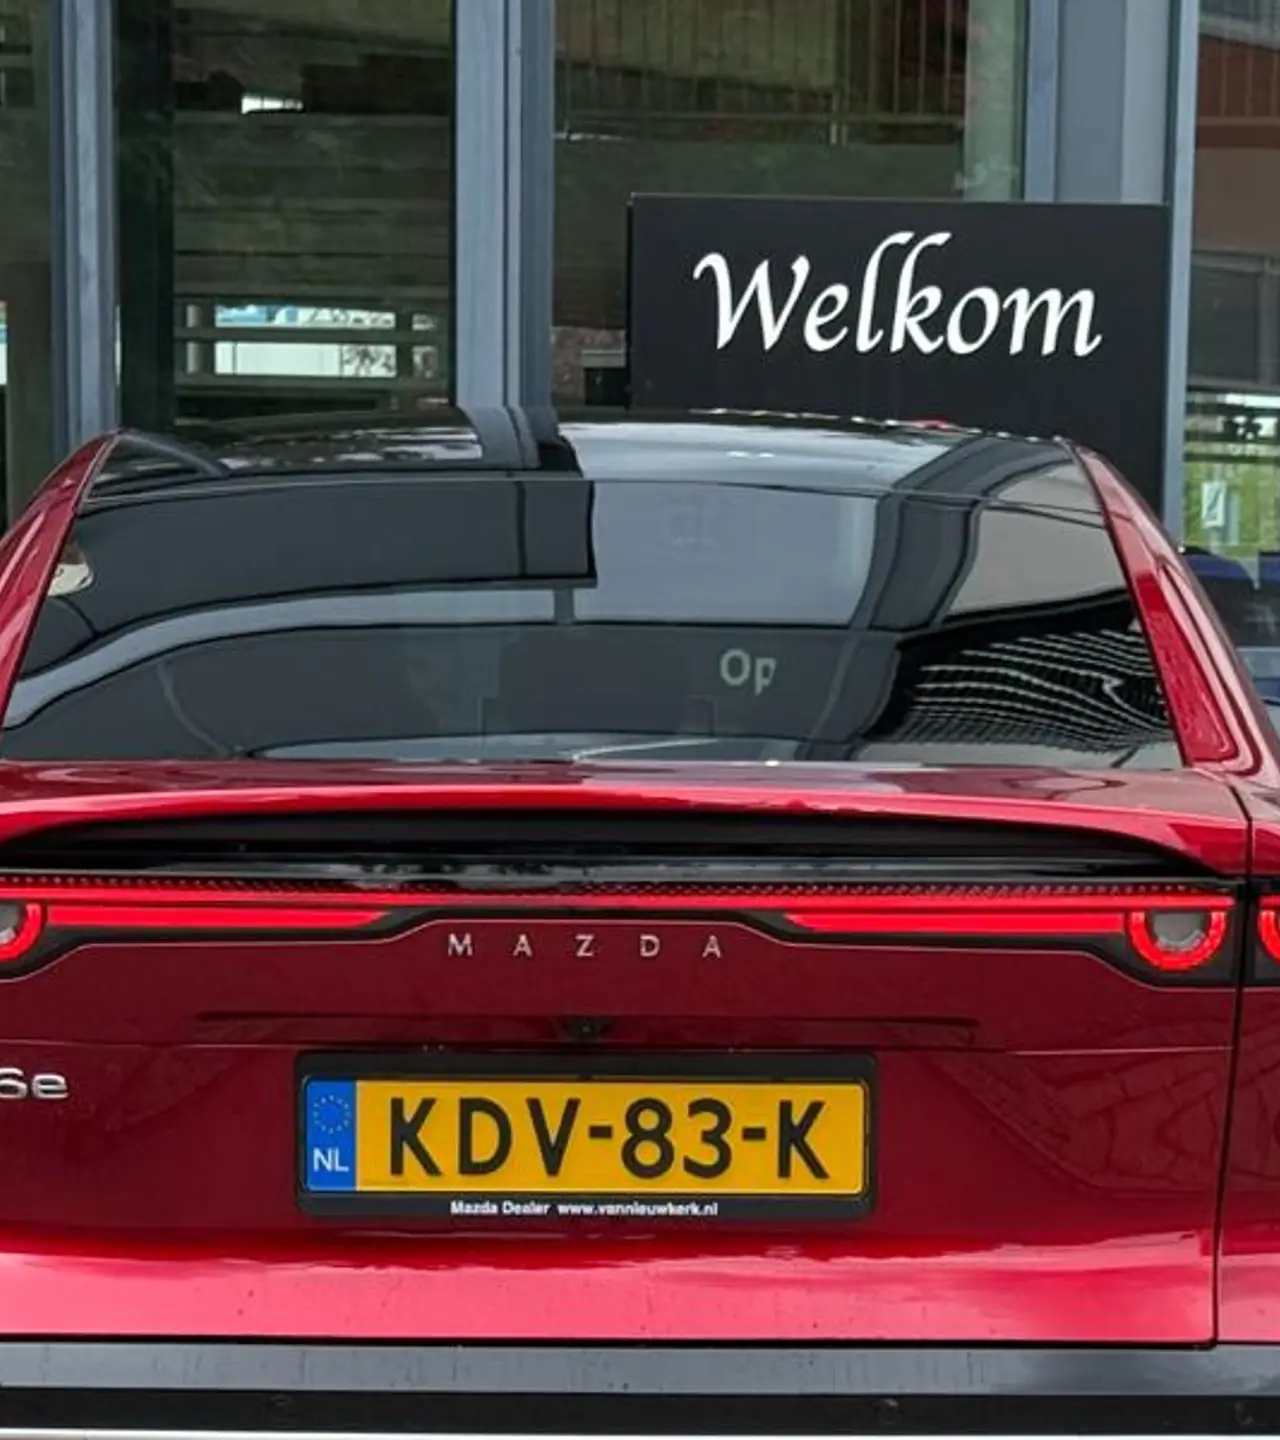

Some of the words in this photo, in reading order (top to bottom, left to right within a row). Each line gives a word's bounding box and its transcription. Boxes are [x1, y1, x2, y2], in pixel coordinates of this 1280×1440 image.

[693, 231, 1103, 357] Welkom
[447, 933, 722, 958] MAZDA
[389, 1096, 830, 1180] KDV-83-K
[313, 1149, 350, 1173] NL
[450, 1201, 497, 1215] Mazda
[502, 1201, 550, 1215] Dealer
[557, 1202, 718, 1216] www.vannieuwkerk.nl
